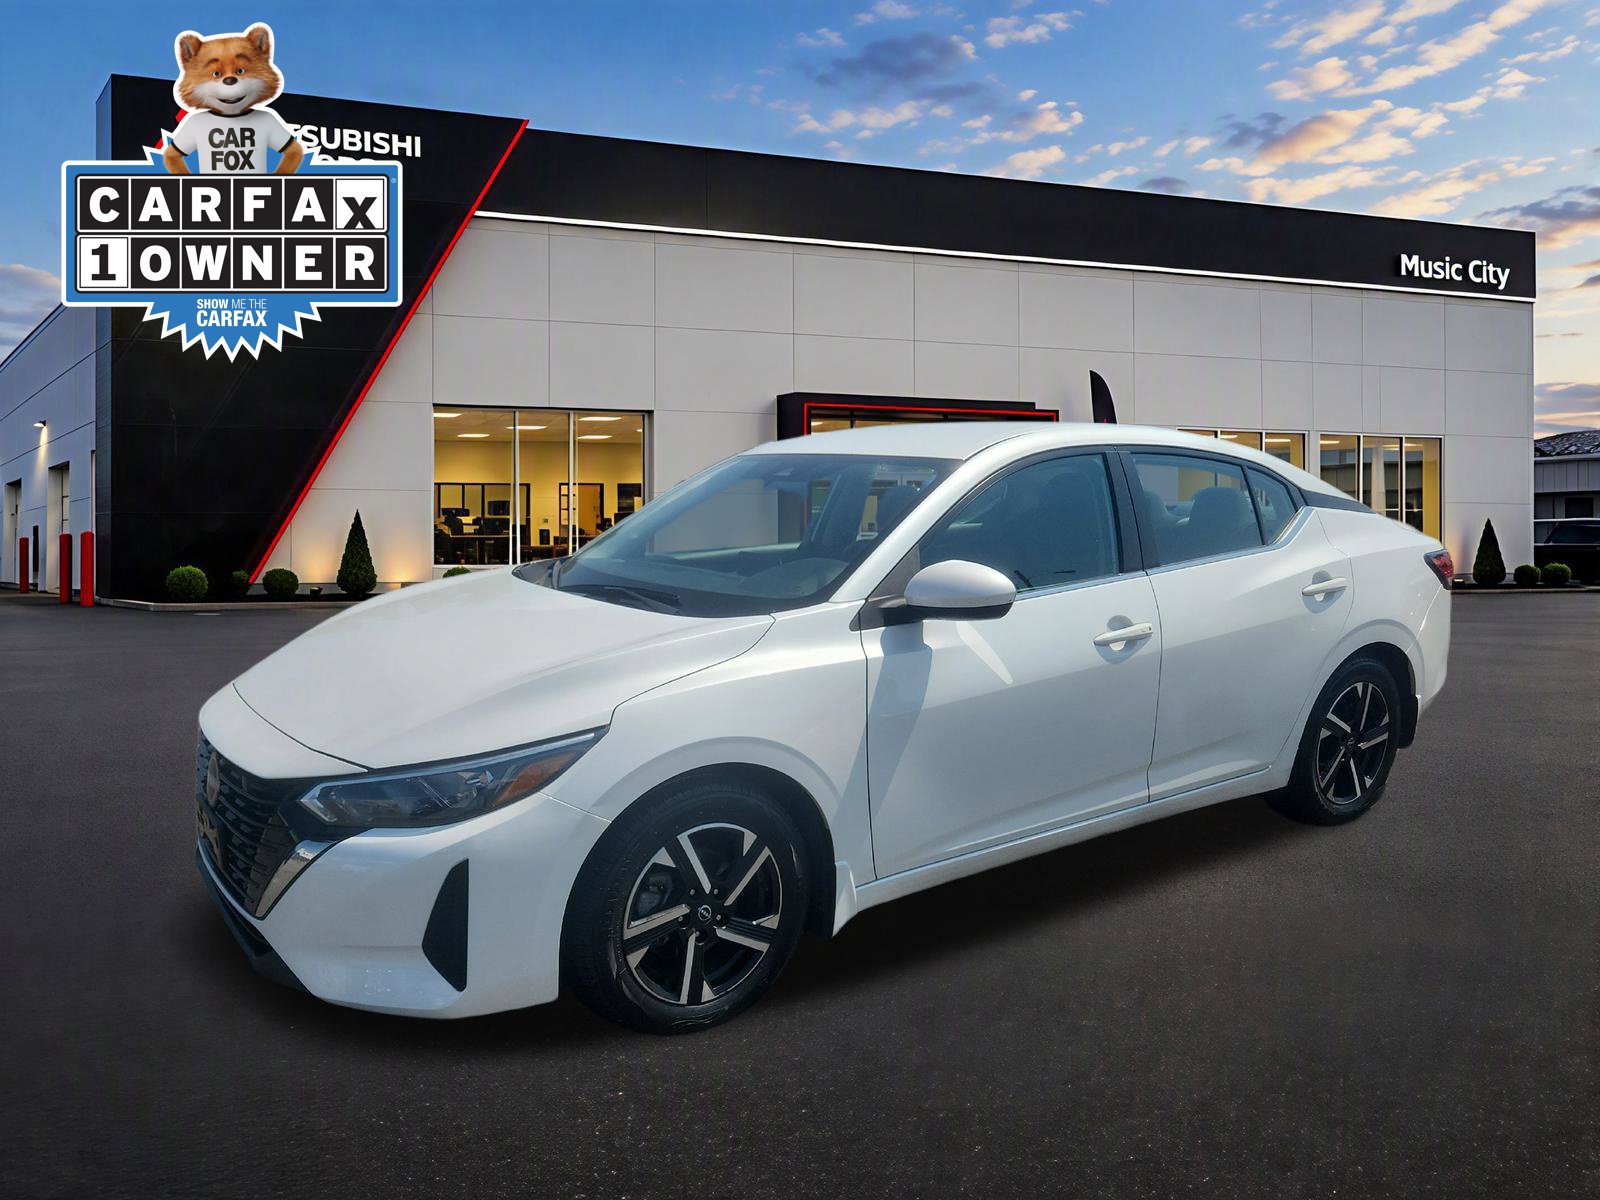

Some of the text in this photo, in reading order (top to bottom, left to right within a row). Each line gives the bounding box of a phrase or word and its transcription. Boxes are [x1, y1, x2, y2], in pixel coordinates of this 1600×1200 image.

[284, 123, 421, 158] SUBISHI
[1400, 253, 1511, 290] Music City
